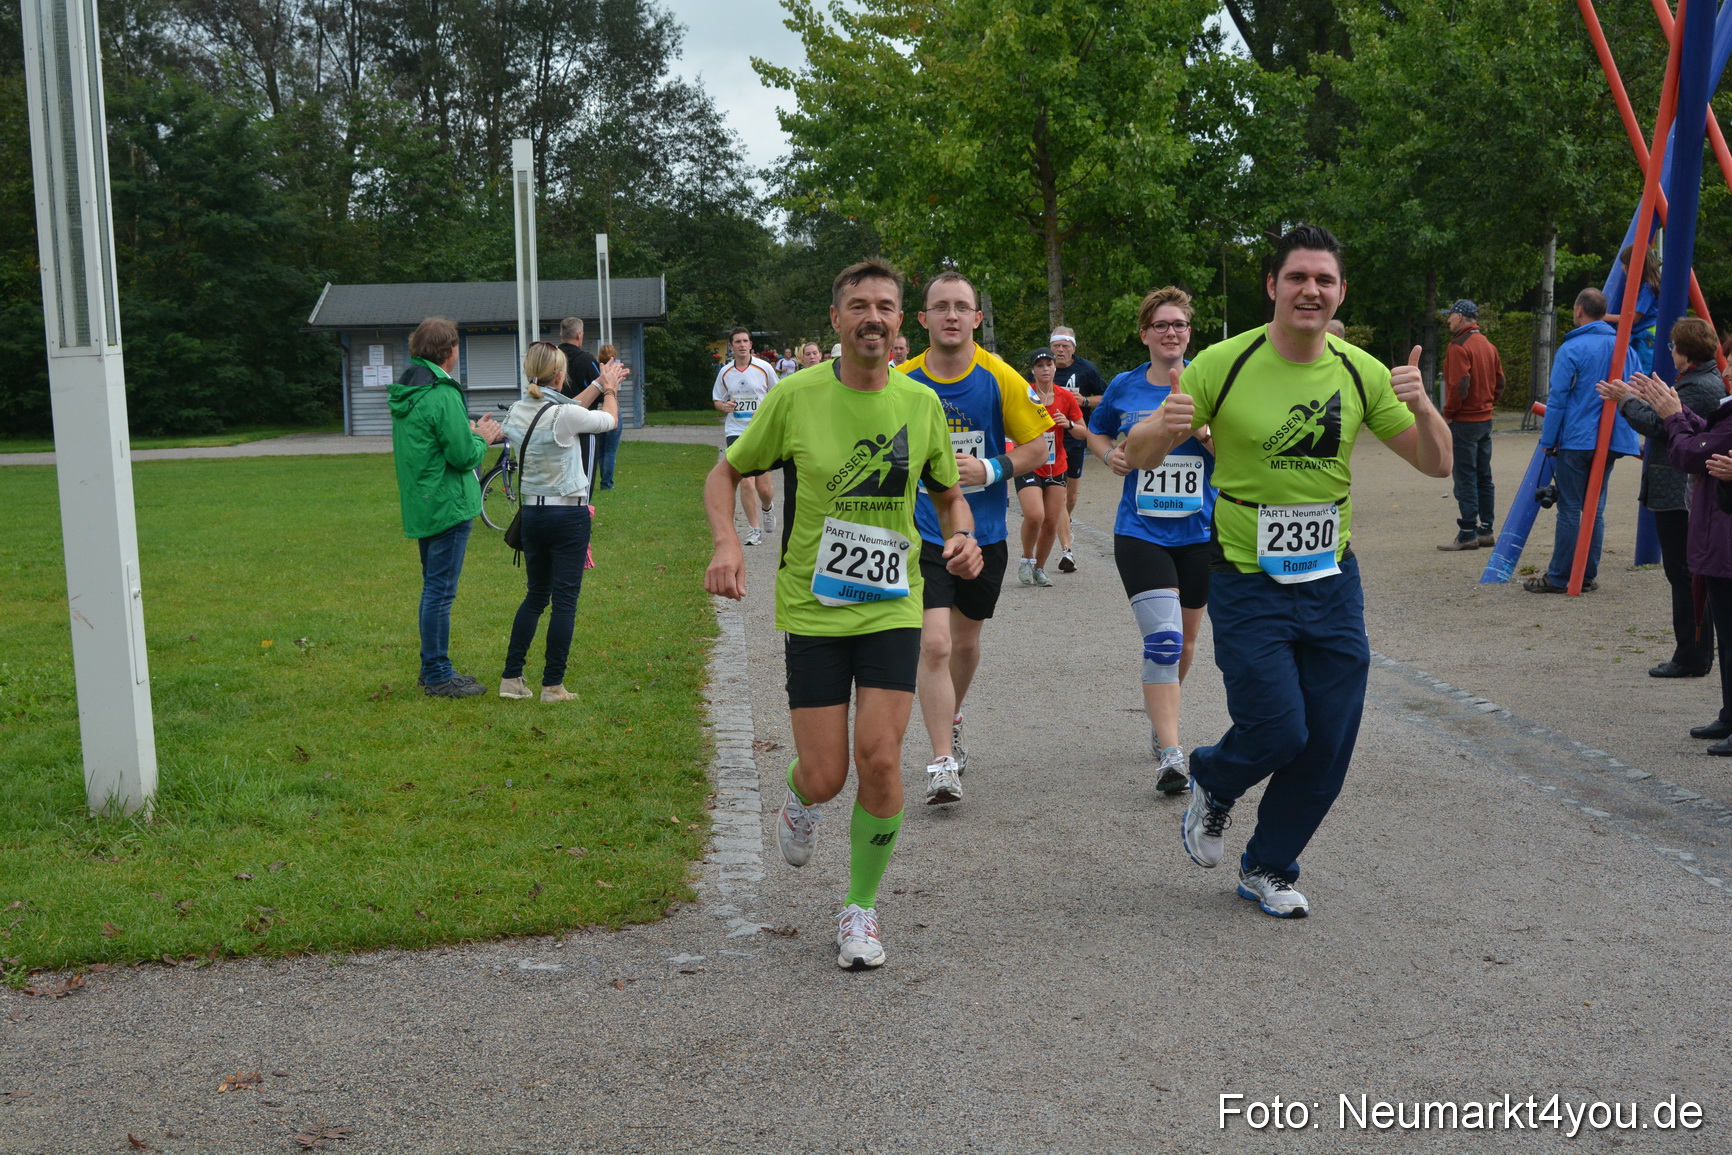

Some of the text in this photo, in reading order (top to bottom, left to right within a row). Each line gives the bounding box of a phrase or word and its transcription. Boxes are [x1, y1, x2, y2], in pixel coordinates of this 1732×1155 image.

[734, 401, 757, 411] 2270
[1262, 413, 1302, 451] GOSSEN
[826, 449, 868, 492] GOSSEN
[1270, 460, 1337, 470] METRAWATT
[1143, 470, 1197, 494] 2118
[835, 501, 905, 512] METRAWATT
[1153, 498, 1184, 510] Sophia
[1259, 507, 1330, 518] PARTL Neumarkt
[825, 525, 897, 548] PARTL Neumarkt
[1267, 518, 1335, 552] 2330
[825, 542, 900, 585] 2238
[1283, 559, 1318, 572] Roman
[838, 584, 882, 602] Jürgen
